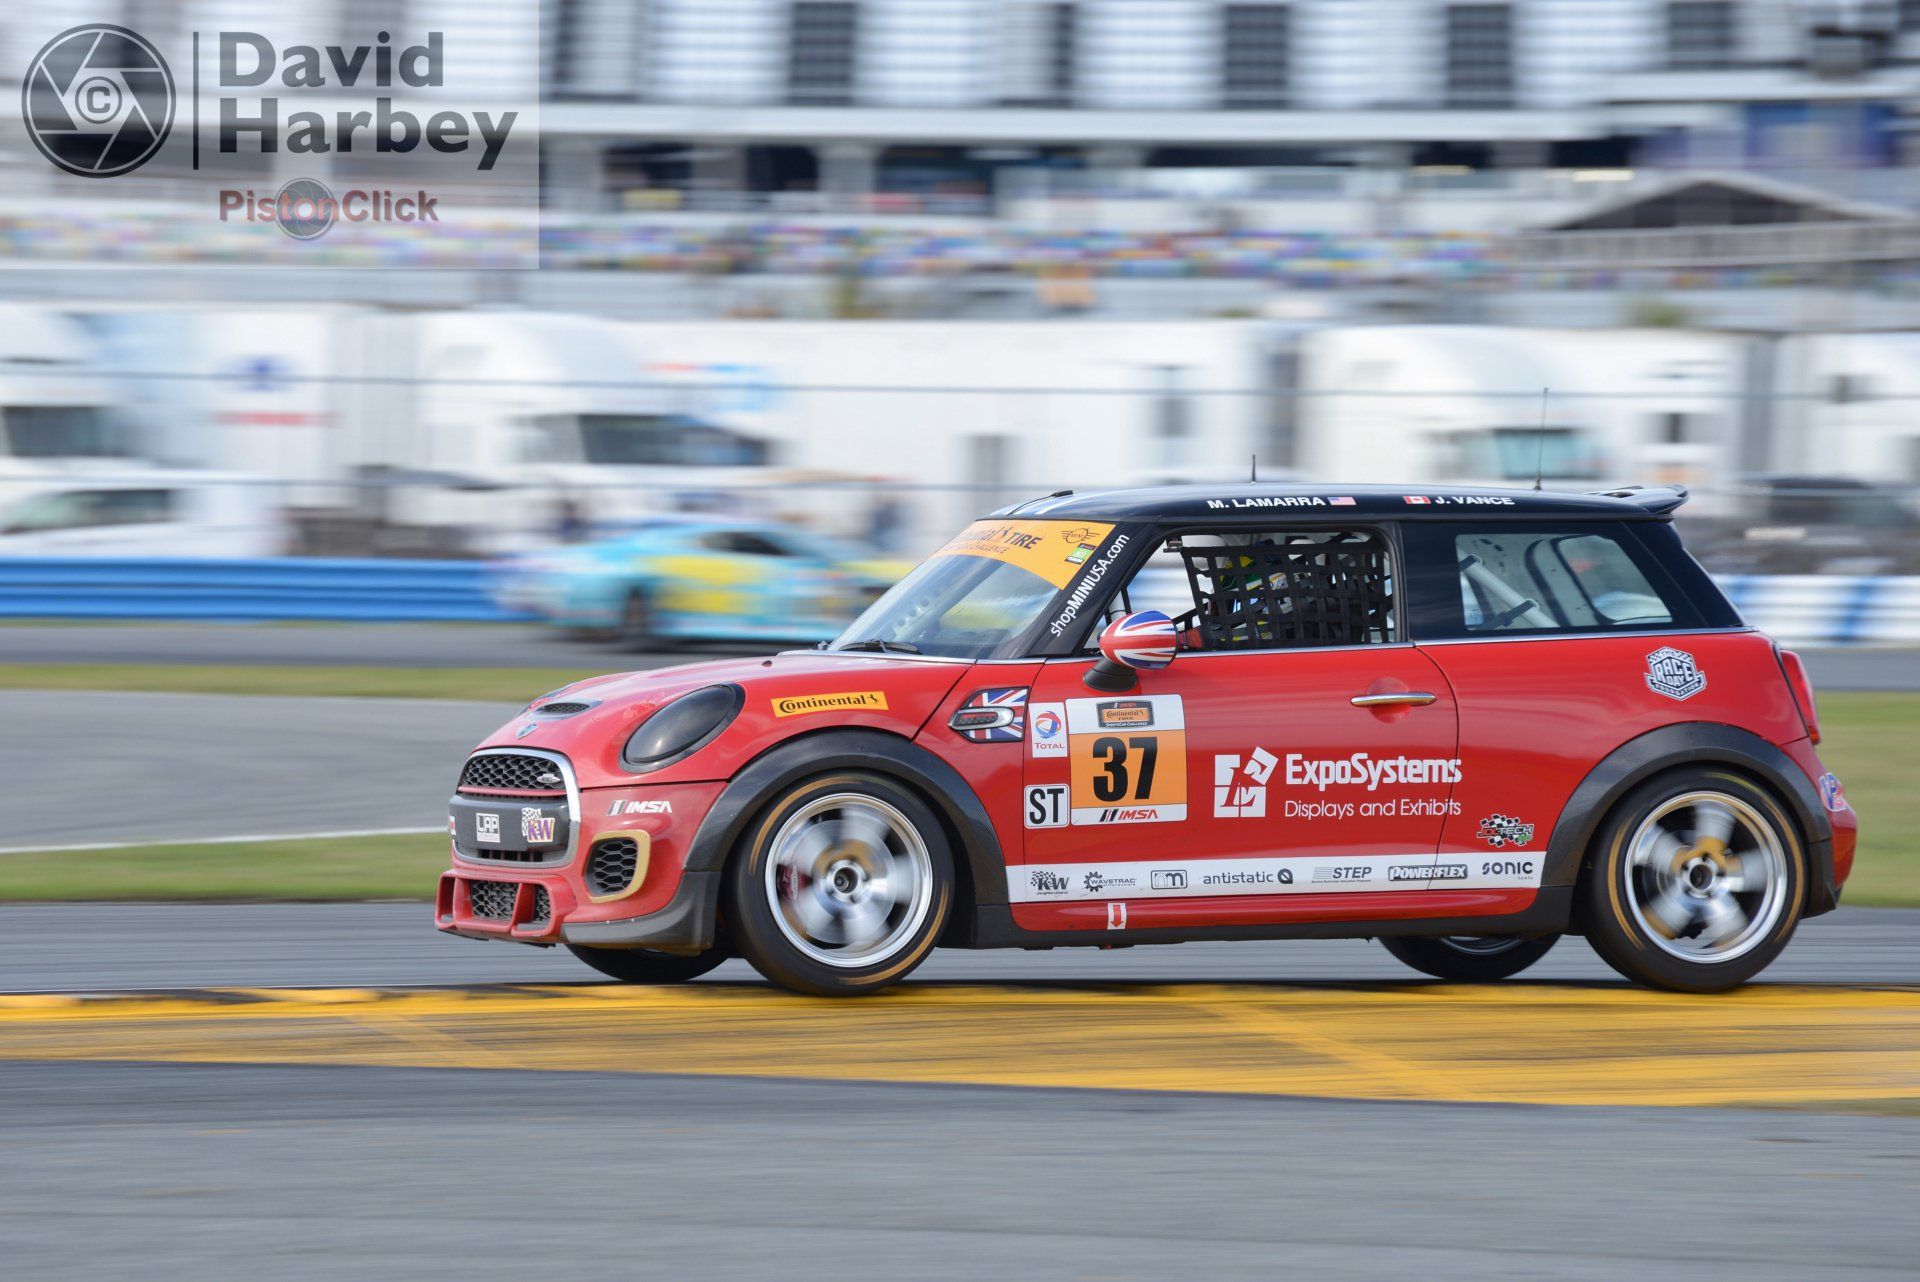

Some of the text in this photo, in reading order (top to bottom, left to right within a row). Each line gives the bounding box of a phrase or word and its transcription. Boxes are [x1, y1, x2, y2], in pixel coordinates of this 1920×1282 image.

[1206, 496, 1327, 509] M. LAMARRA
[1435, 496, 1516, 506] J. VANCE
[1050, 534, 1130, 638] shopMINIUSA.com
[1654, 658, 1694, 683] RACE
[779, 694, 867, 714] Continental
[1034, 742, 1065, 750] TOTAL
[1091, 736, 1158, 803] 37
[1285, 752, 1463, 791] ExpoSystems
[624, 800, 673, 814] IMSA
[1028, 788, 1065, 825] ST
[1285, 799, 1462, 820] Displays and Exhibits
[1118, 809, 1159, 820] IMSA
[1203, 871, 1274, 885] antistatic
[1332, 866, 1372, 879] STEP
[1388, 866, 1467, 881] POWERFLEX
